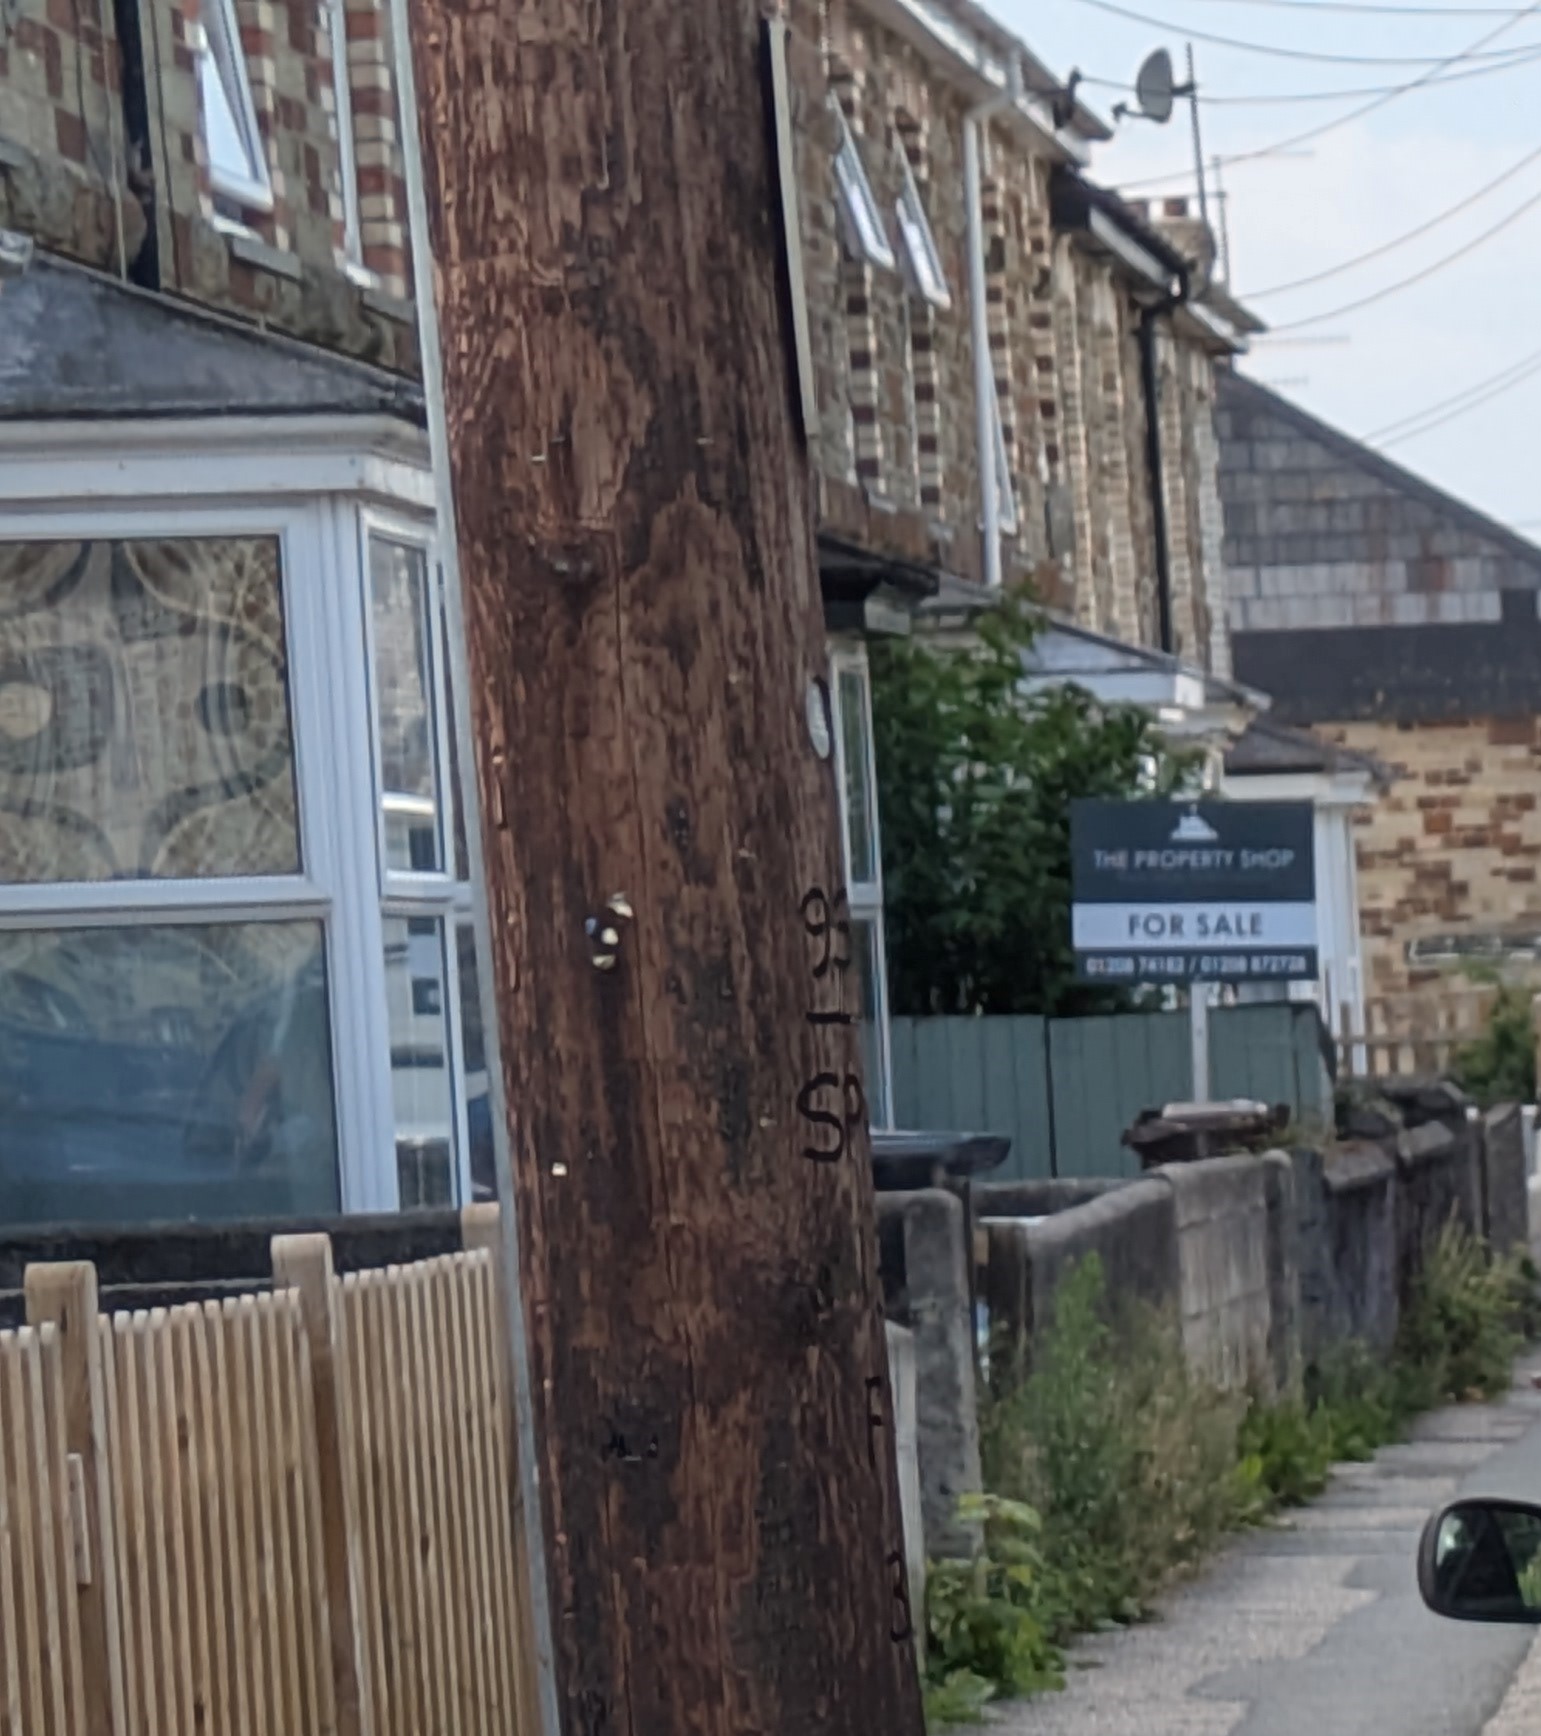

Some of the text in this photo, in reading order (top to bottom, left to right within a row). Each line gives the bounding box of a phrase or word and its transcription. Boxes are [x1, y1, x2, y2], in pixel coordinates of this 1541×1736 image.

[1093, 850, 1296, 869] THE PROPERTY SHOP
[1128, 912, 1264, 938] FOR SALE
